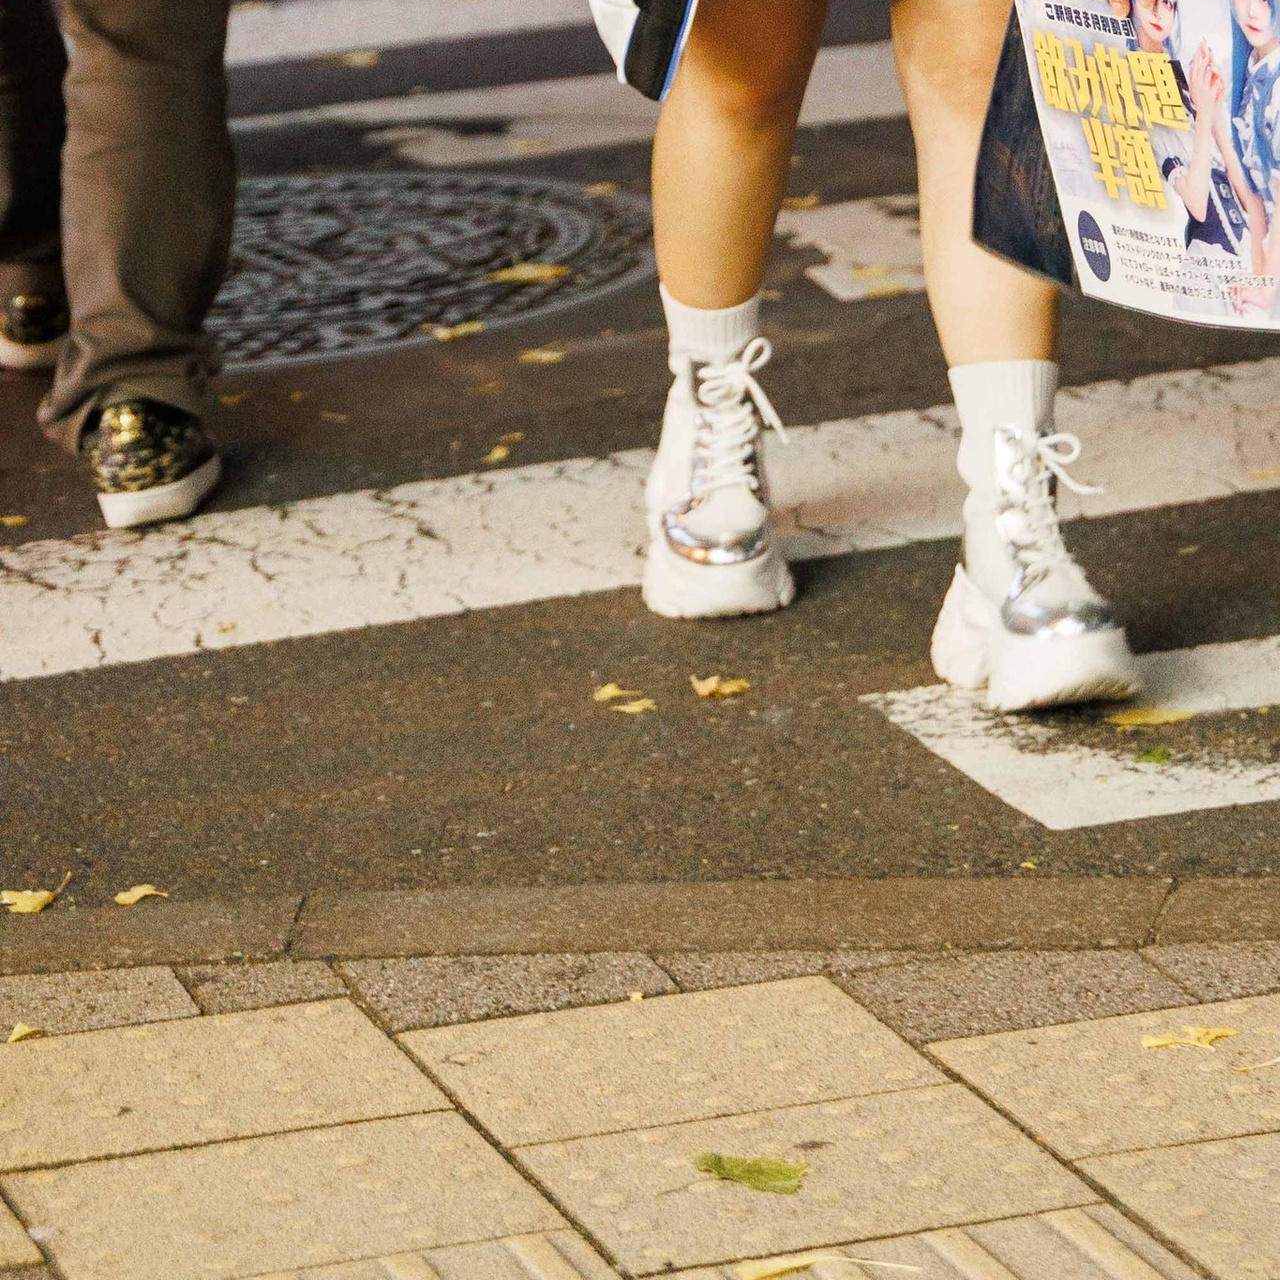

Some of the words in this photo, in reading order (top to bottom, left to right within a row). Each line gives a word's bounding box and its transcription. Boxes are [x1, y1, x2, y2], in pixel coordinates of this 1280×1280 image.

[1033, 31, 1191, 131] 飲み放題
[1081, 117, 1167, 209] 半額
